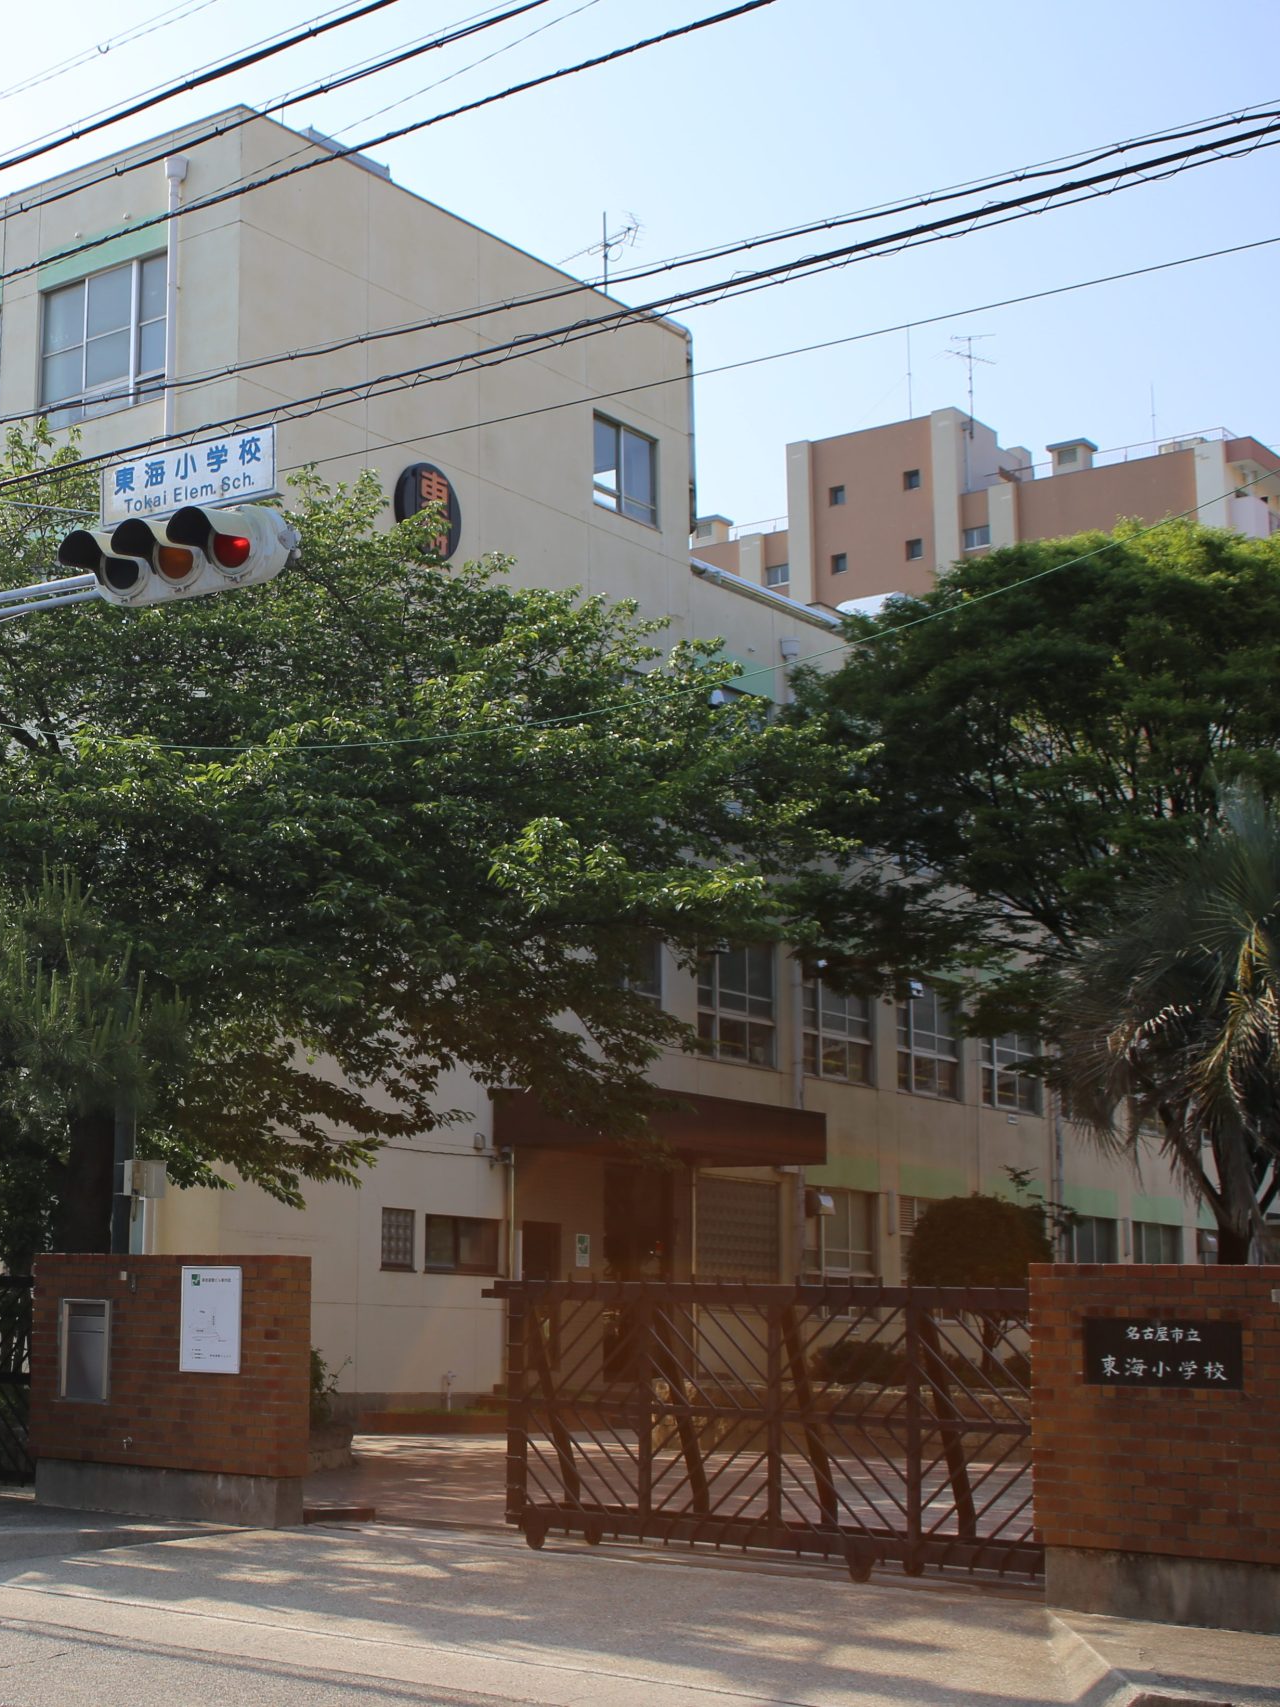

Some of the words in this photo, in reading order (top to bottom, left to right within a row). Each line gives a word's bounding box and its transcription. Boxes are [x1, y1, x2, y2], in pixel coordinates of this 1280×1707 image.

[114, 436, 262, 496] 東海小学校
[124, 490, 167, 513] Tokai
[173, 482, 217, 503] Elem.
[221, 471, 255, 493] Sch.
[1125, 1326, 1202, 1343] 名古屋市立
[1100, 1354, 1228, 1381] 東海小学校
